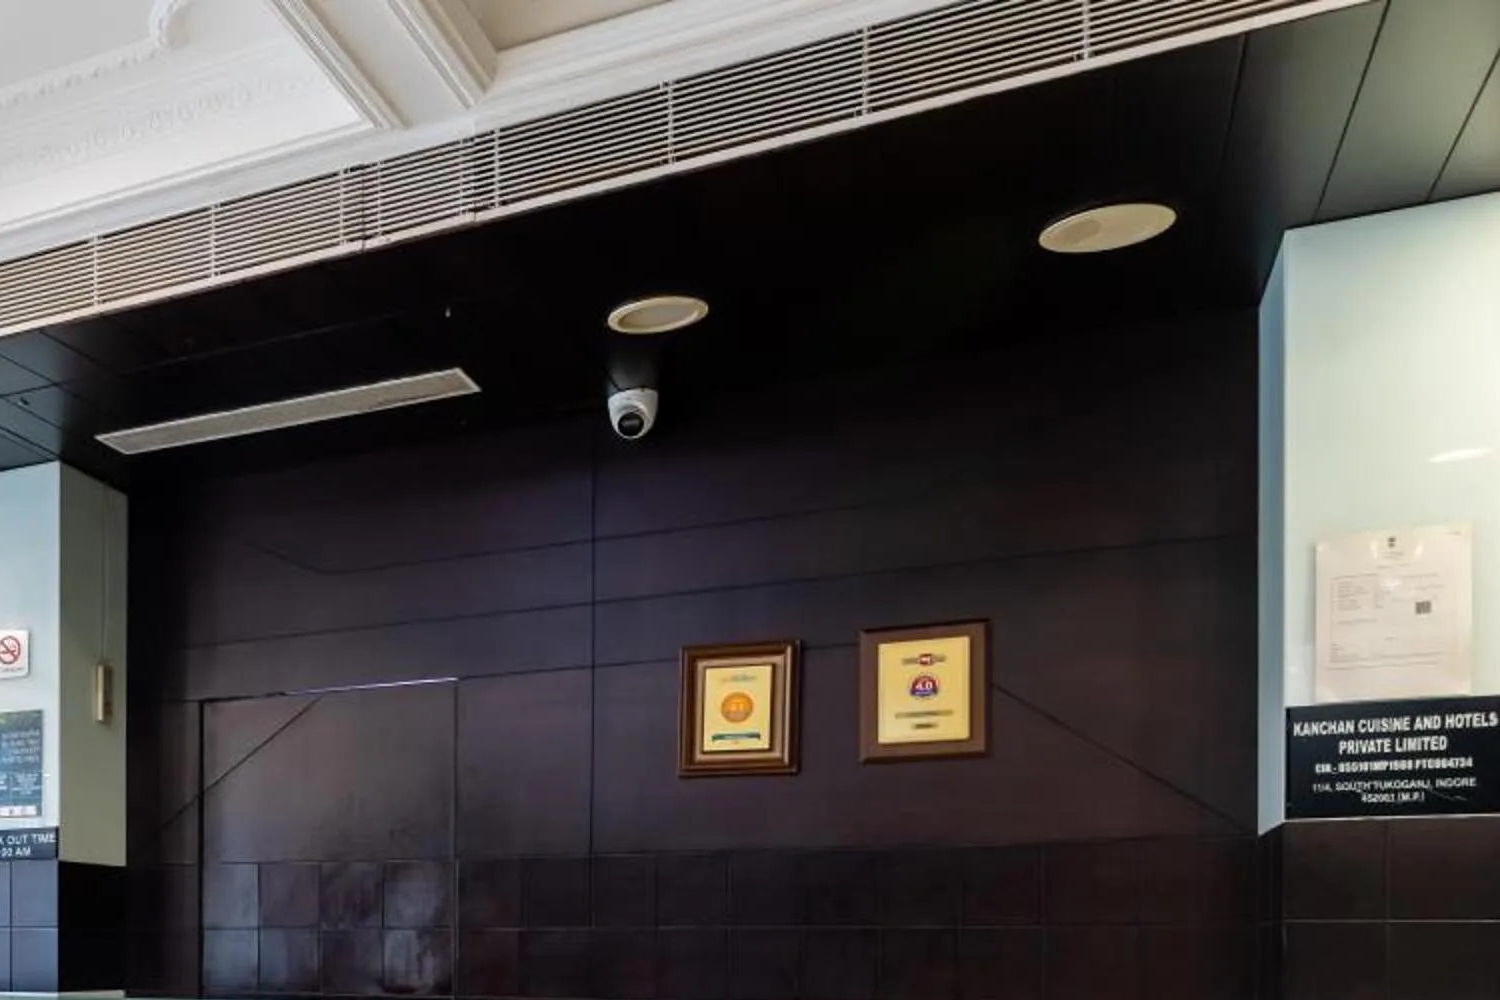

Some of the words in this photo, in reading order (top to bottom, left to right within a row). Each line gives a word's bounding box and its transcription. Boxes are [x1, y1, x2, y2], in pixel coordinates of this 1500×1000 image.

[1293, 719, 1355, 737] KANCHAN
[1357, 716, 1411, 733] CUISINE
[1413, 714, 1442, 731] AND
[1444, 711, 1499, 729] HOTELS
[1338, 738, 1393, 755] PRIVATE
[1395, 735, 1449, 752] LIMITED
[6, 834, 29, 846] OUT
[30, 831, 56, 845] TIME
[15, 846, 32, 857] AM
